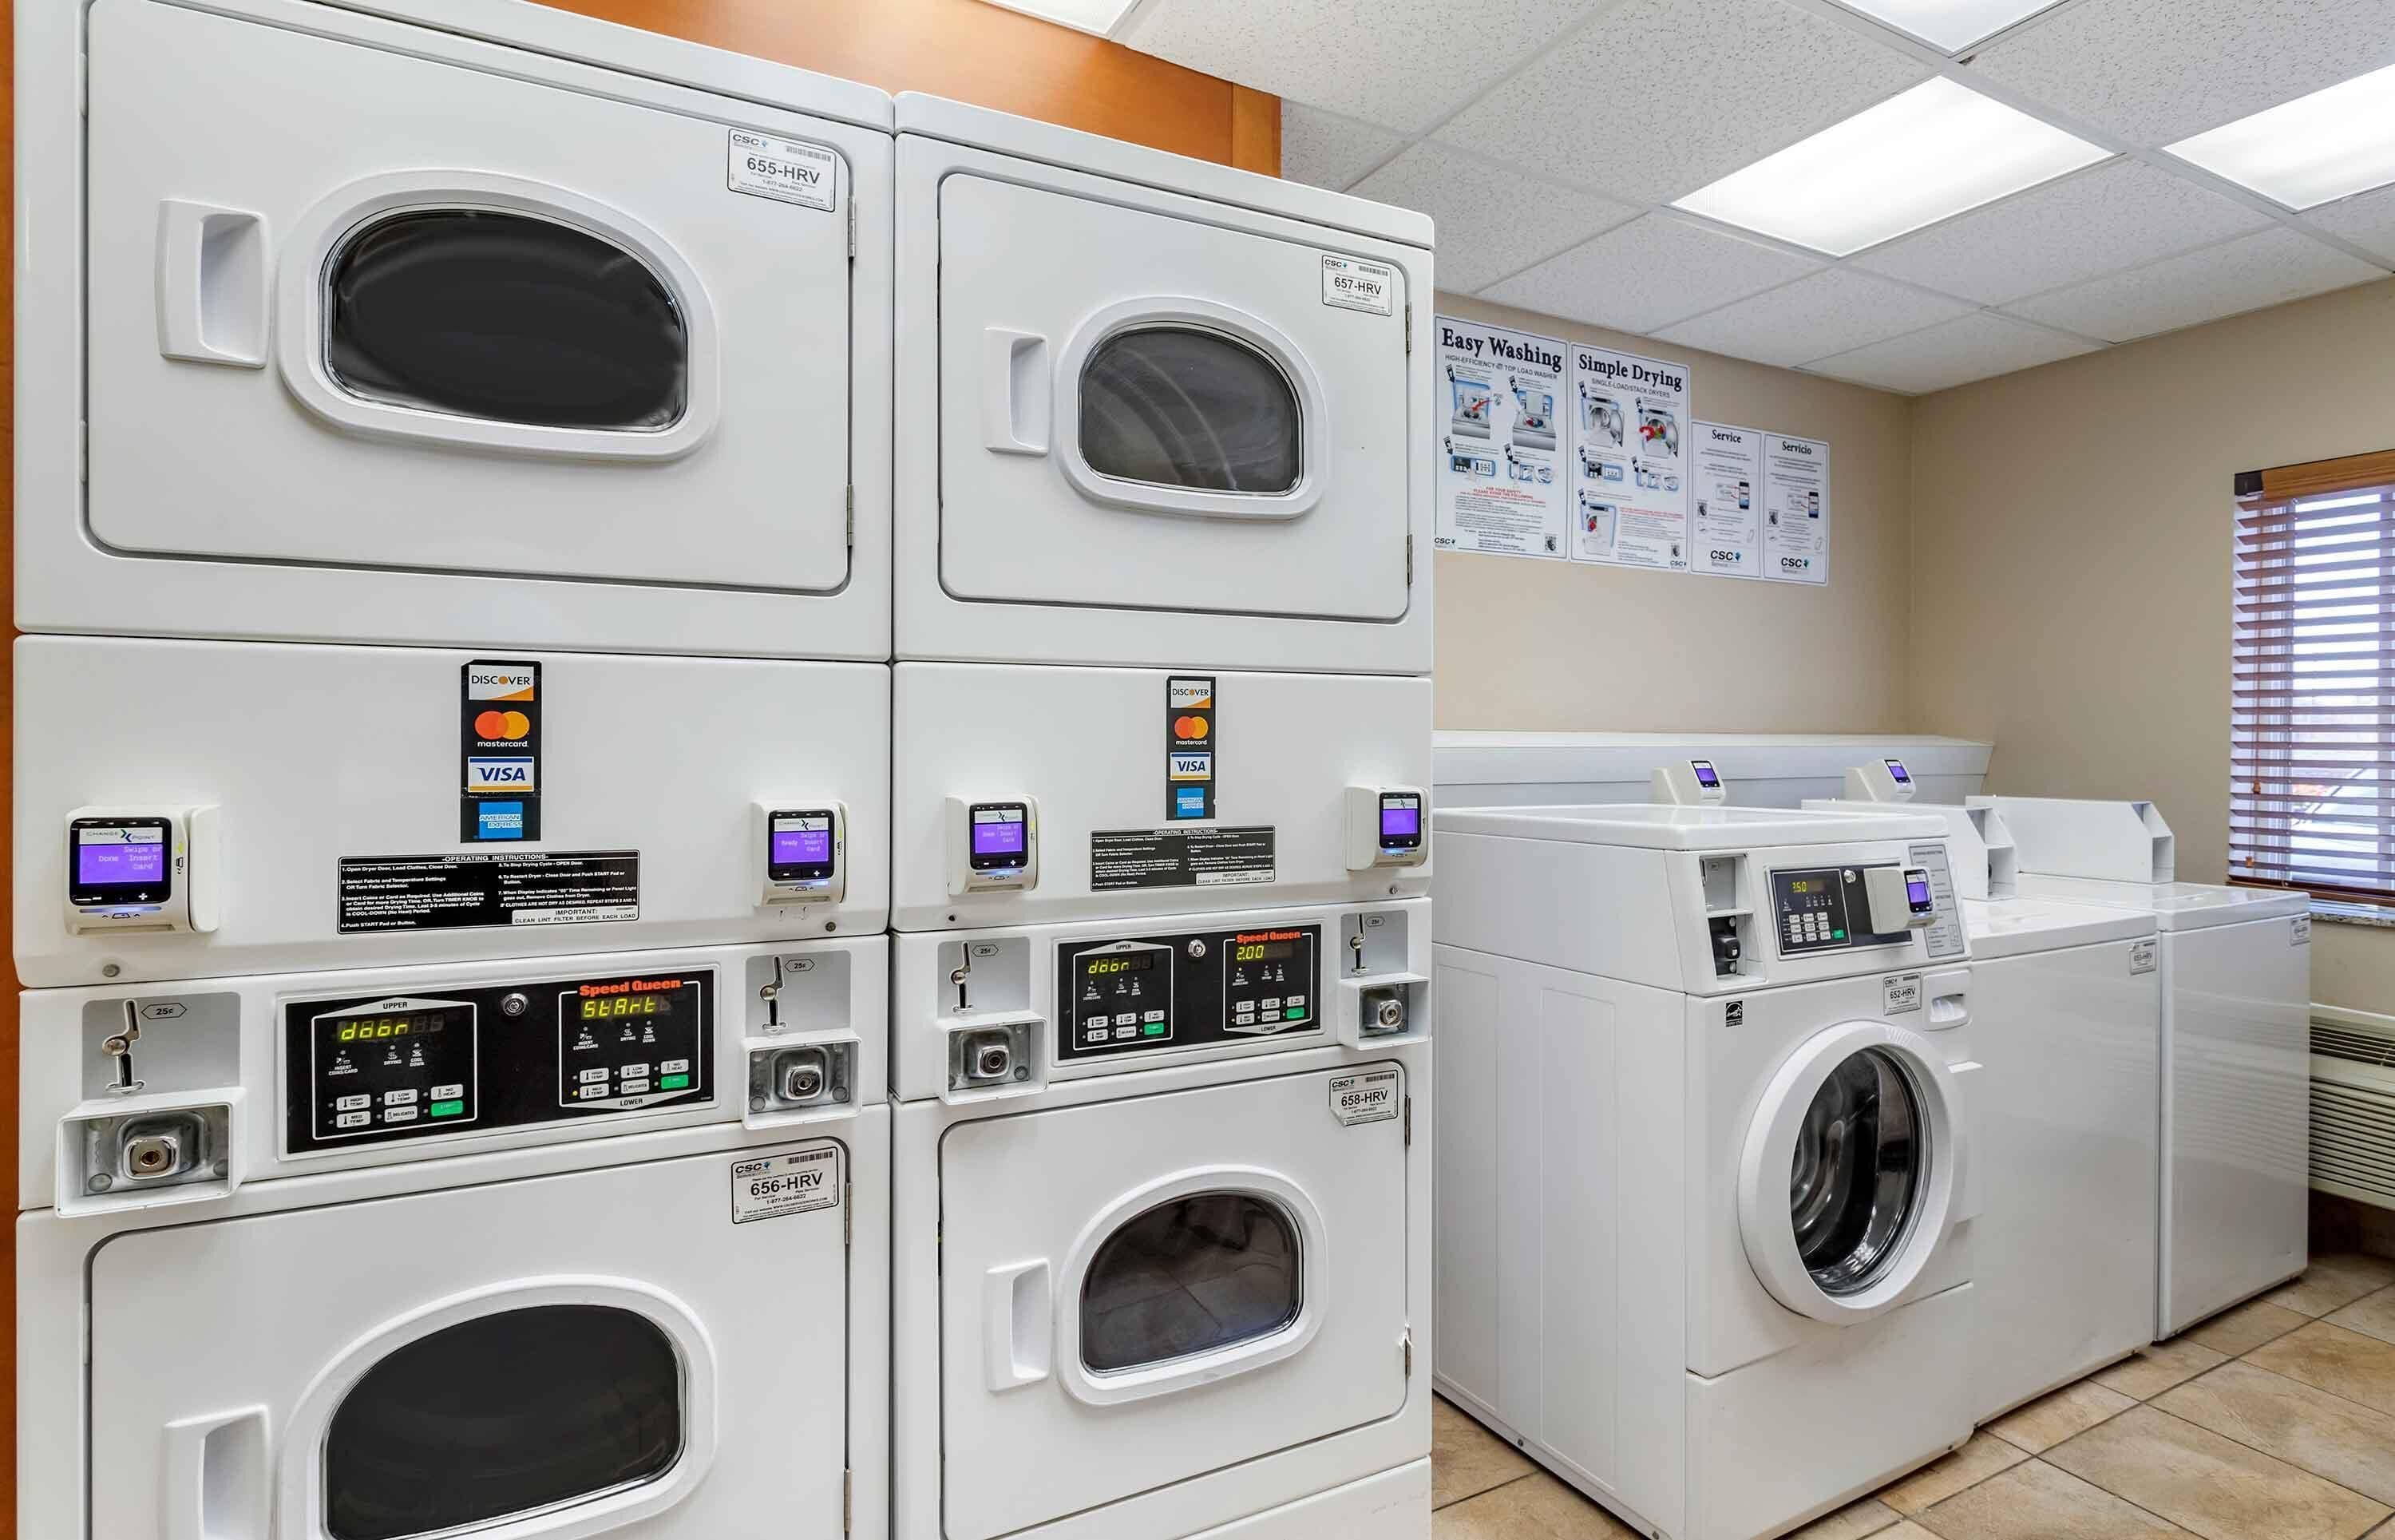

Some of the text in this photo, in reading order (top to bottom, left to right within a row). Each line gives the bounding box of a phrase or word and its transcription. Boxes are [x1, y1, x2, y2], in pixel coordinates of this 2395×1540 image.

[732, 134, 759, 146] CSC
[746, 157, 820, 184] 655-HRV
[1324, 259, 1342, 267] CSC
[1334, 276, 1382, 295] 657-HRV
[1442, 327, 1562, 373] Easy Washing
[1579, 354, 1682, 392] Simple Drying
[1712, 429, 1742, 444] Service
[1782, 441, 1812, 455] Servicio
[1710, 550, 1734, 560] CSC
[1781, 557, 1803, 568] CSC
[472, 675, 530, 685] DISCOVER
[1177, 760, 1206, 772] VISA
[477, 767, 526, 782] VISA
[1237, 931, 1300, 944] Speed Queen
[1088, 960, 1129, 974] door
[580, 980, 681, 997] Speed Queen
[1890, 988, 1916, 1000] 652-HRV
[341, 1021, 409, 1041] door
[1332, 1079, 1349, 1088] CSC
[1341, 1090, 1388, 1107] 658-HRV
[735, 1162, 762, 1174] CSC
[750, 1172, 823, 1196] 656-HRV
